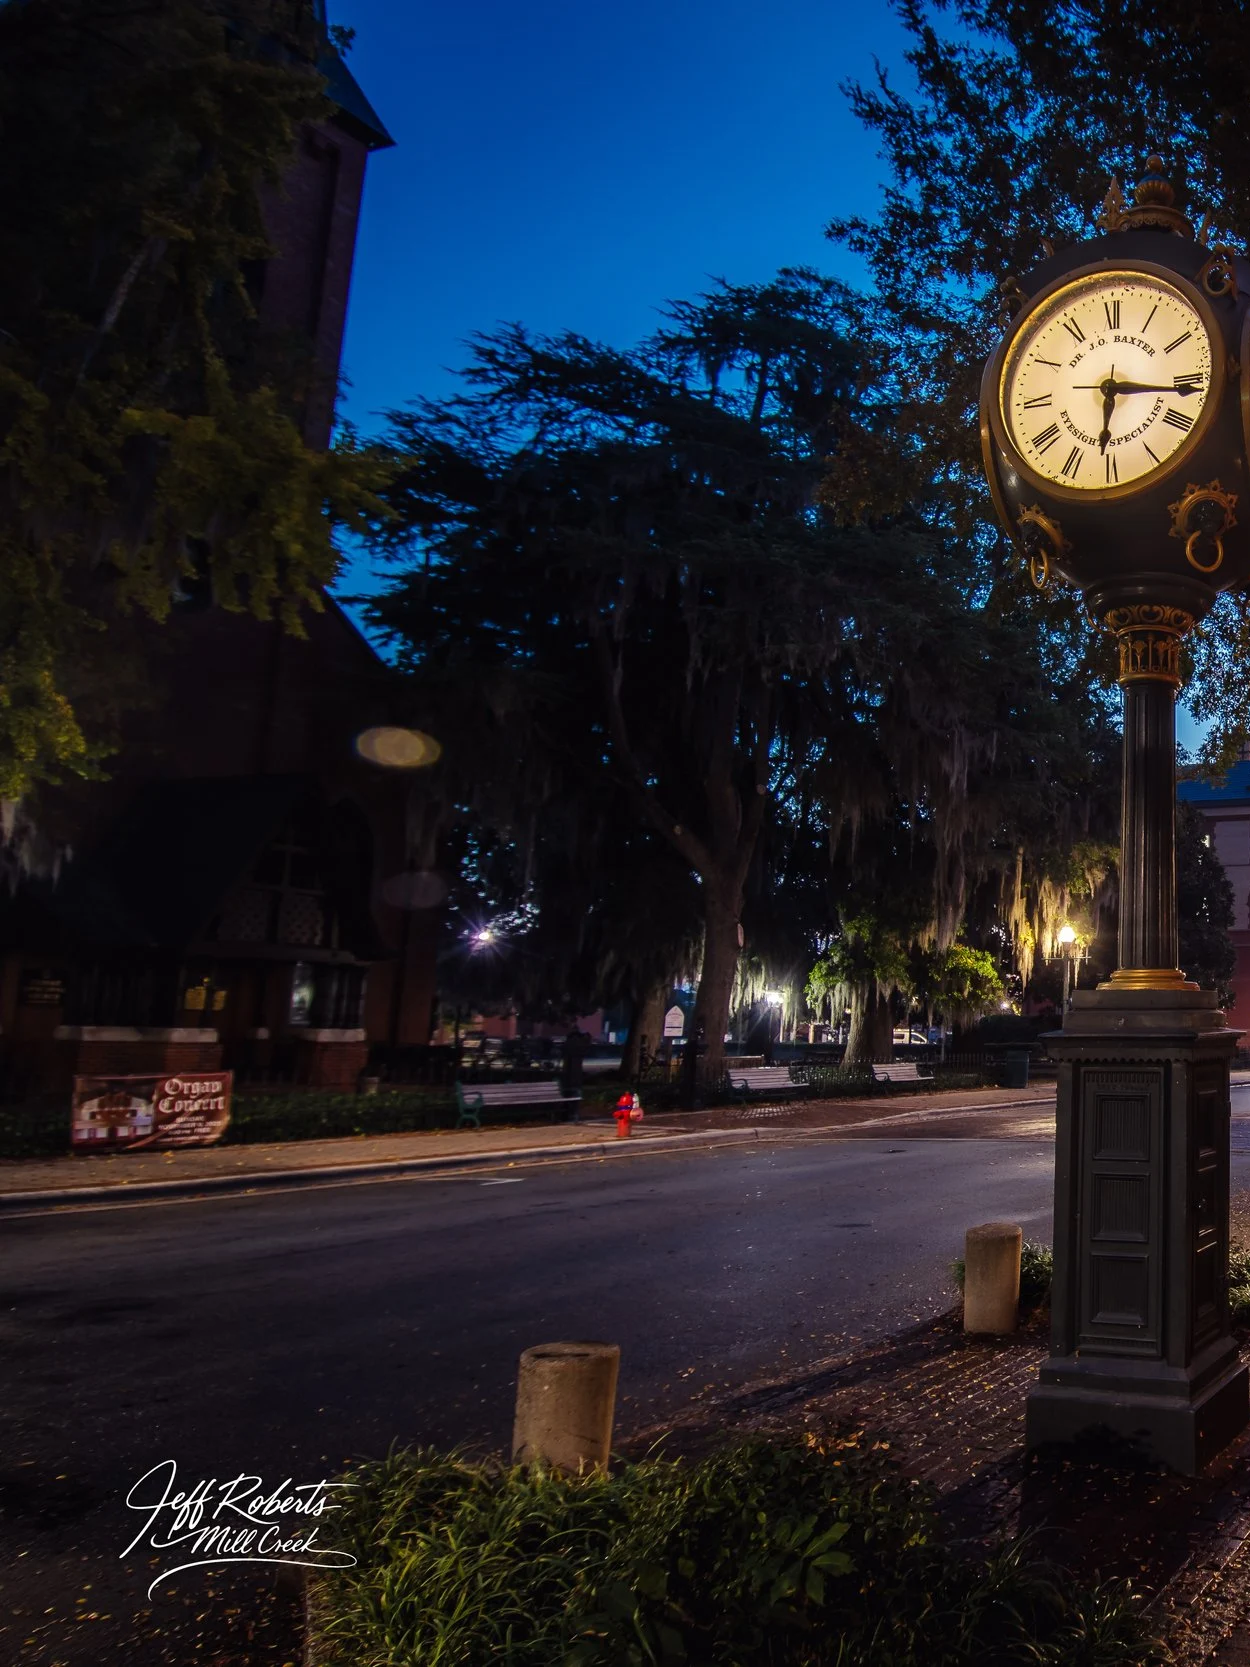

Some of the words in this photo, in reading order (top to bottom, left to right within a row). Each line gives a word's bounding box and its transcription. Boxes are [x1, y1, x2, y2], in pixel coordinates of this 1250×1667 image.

[1069, 352, 1087, 368] DR.
[1089, 339, 1108, 351] J.O.
[1113, 335, 1157, 358] BAXTER
[1060, 410, 1103, 448] EYESIGHT
[1109, 397, 1165, 447] SPECIALIST
[164, 1078, 223, 1098] Organ
[158, 1095, 225, 1114] Concert
